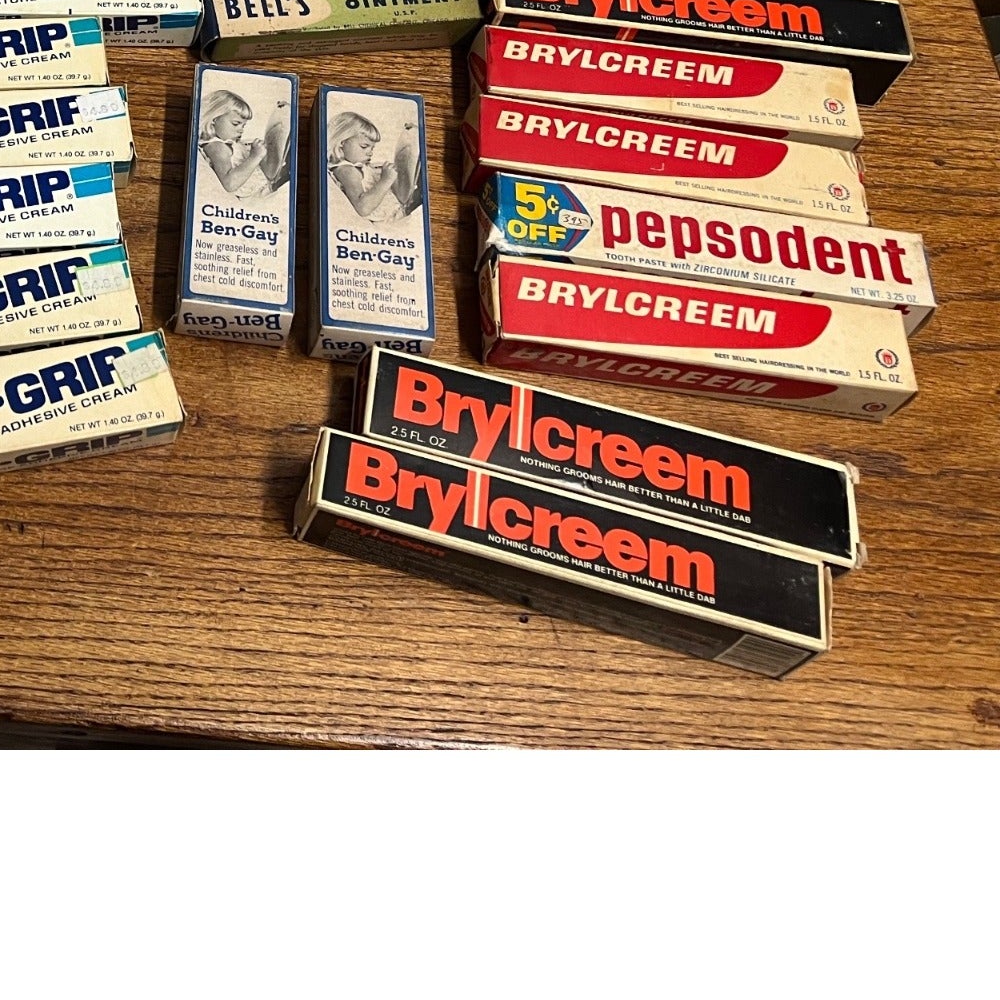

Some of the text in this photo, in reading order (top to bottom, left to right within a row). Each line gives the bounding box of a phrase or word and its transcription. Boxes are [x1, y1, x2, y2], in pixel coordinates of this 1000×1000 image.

[502, 40, 735, 86] BRYLCREEM
[496, 110, 737, 166] BRYLCREEM
[201, 204, 280, 224] Children's
[514, 183, 559, 221] 5¢
[336, 229, 415, 250] Children's
[507, 219, 567, 244] OFF
[600, 204, 912, 285] pepsodent
[605, 253, 797, 285] TOOTH PASTE with ZIRCONIUM SILICATE
[517, 277, 777, 335] BRYLCREEM
[0, 404, 77, 436] ADHESIVE
[81, 383, 138, 409] CREAM
[393, 366, 751, 512] Brylcreem
[345, 443, 716, 595] Brylcreem
[488, 534, 716, 604] NOTHING GROOMS HAIR BETTER THAN A LITTLE DAB
